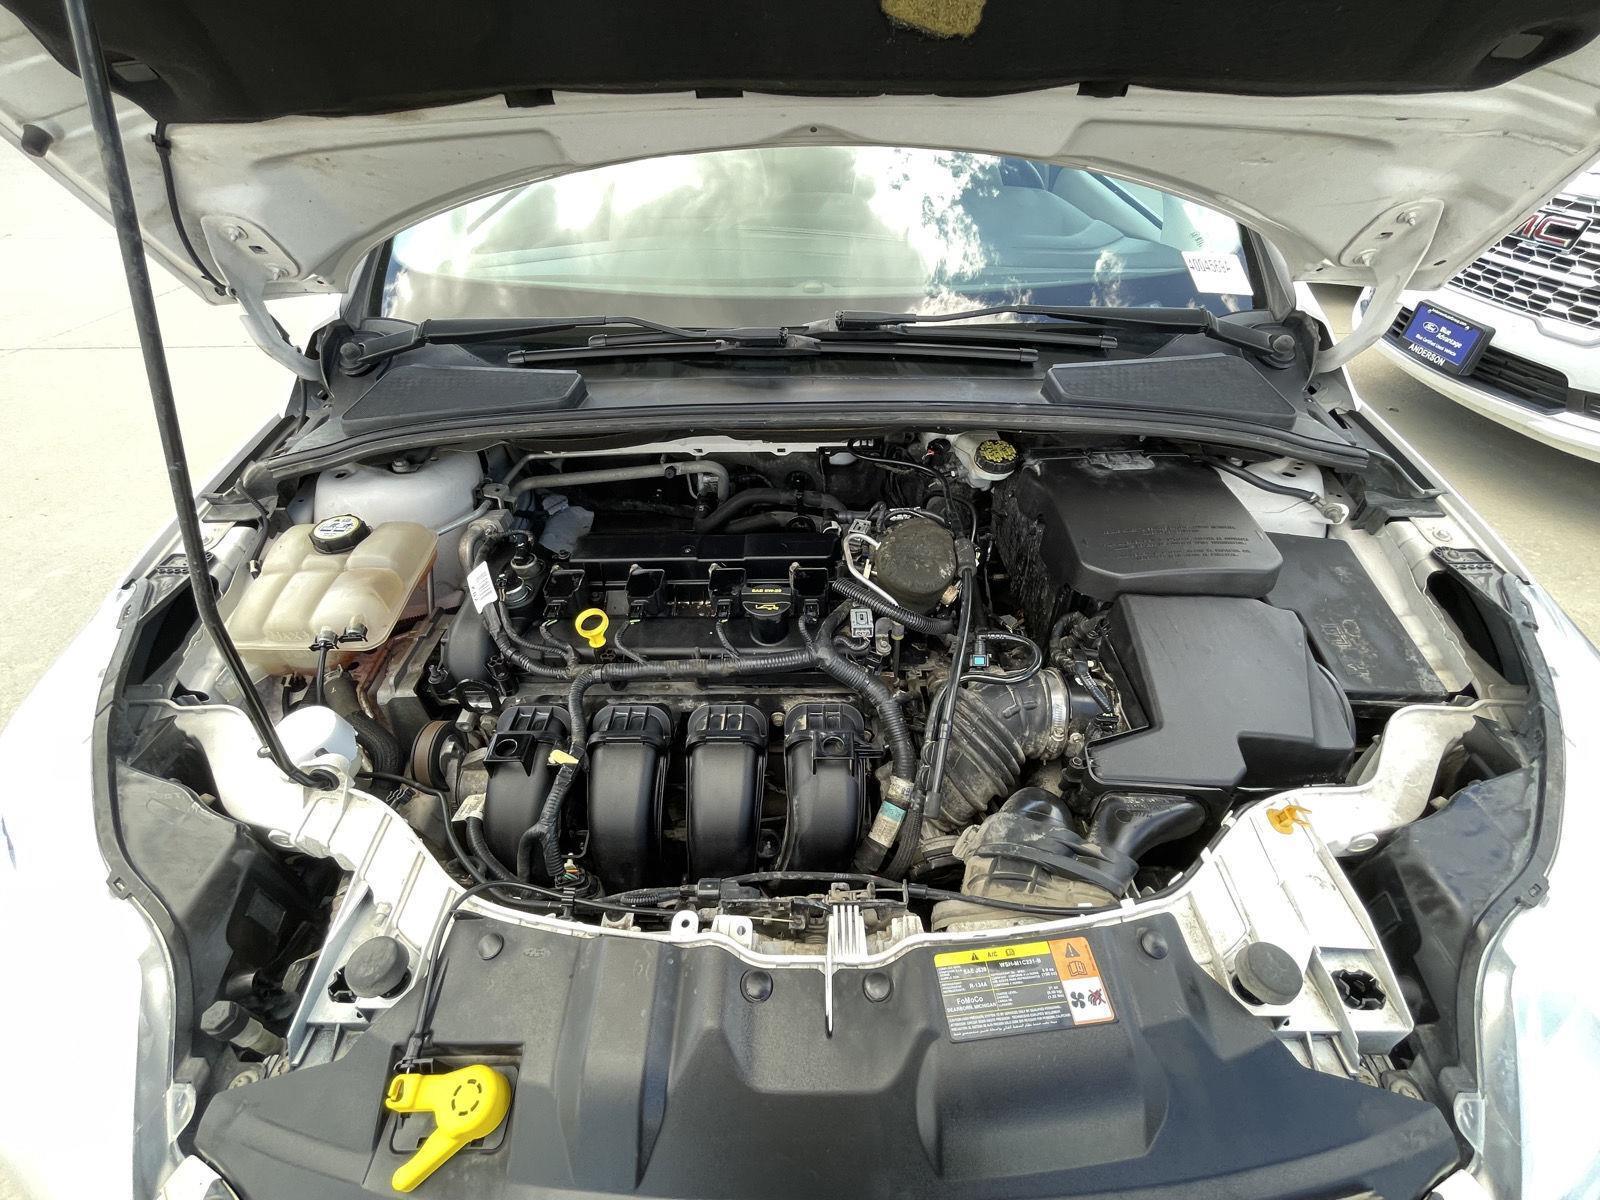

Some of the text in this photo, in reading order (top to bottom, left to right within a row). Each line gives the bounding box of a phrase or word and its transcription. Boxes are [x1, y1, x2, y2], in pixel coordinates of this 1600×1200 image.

[1439, 326, 1451, 336] Blue
[1436, 332, 1463, 349] Advantage
[1408, 343, 1446, 366] ANDERSON
[956, 996, 984, 1005] FoMoCo
[974, 1002, 997, 1011] MICHIGAN
